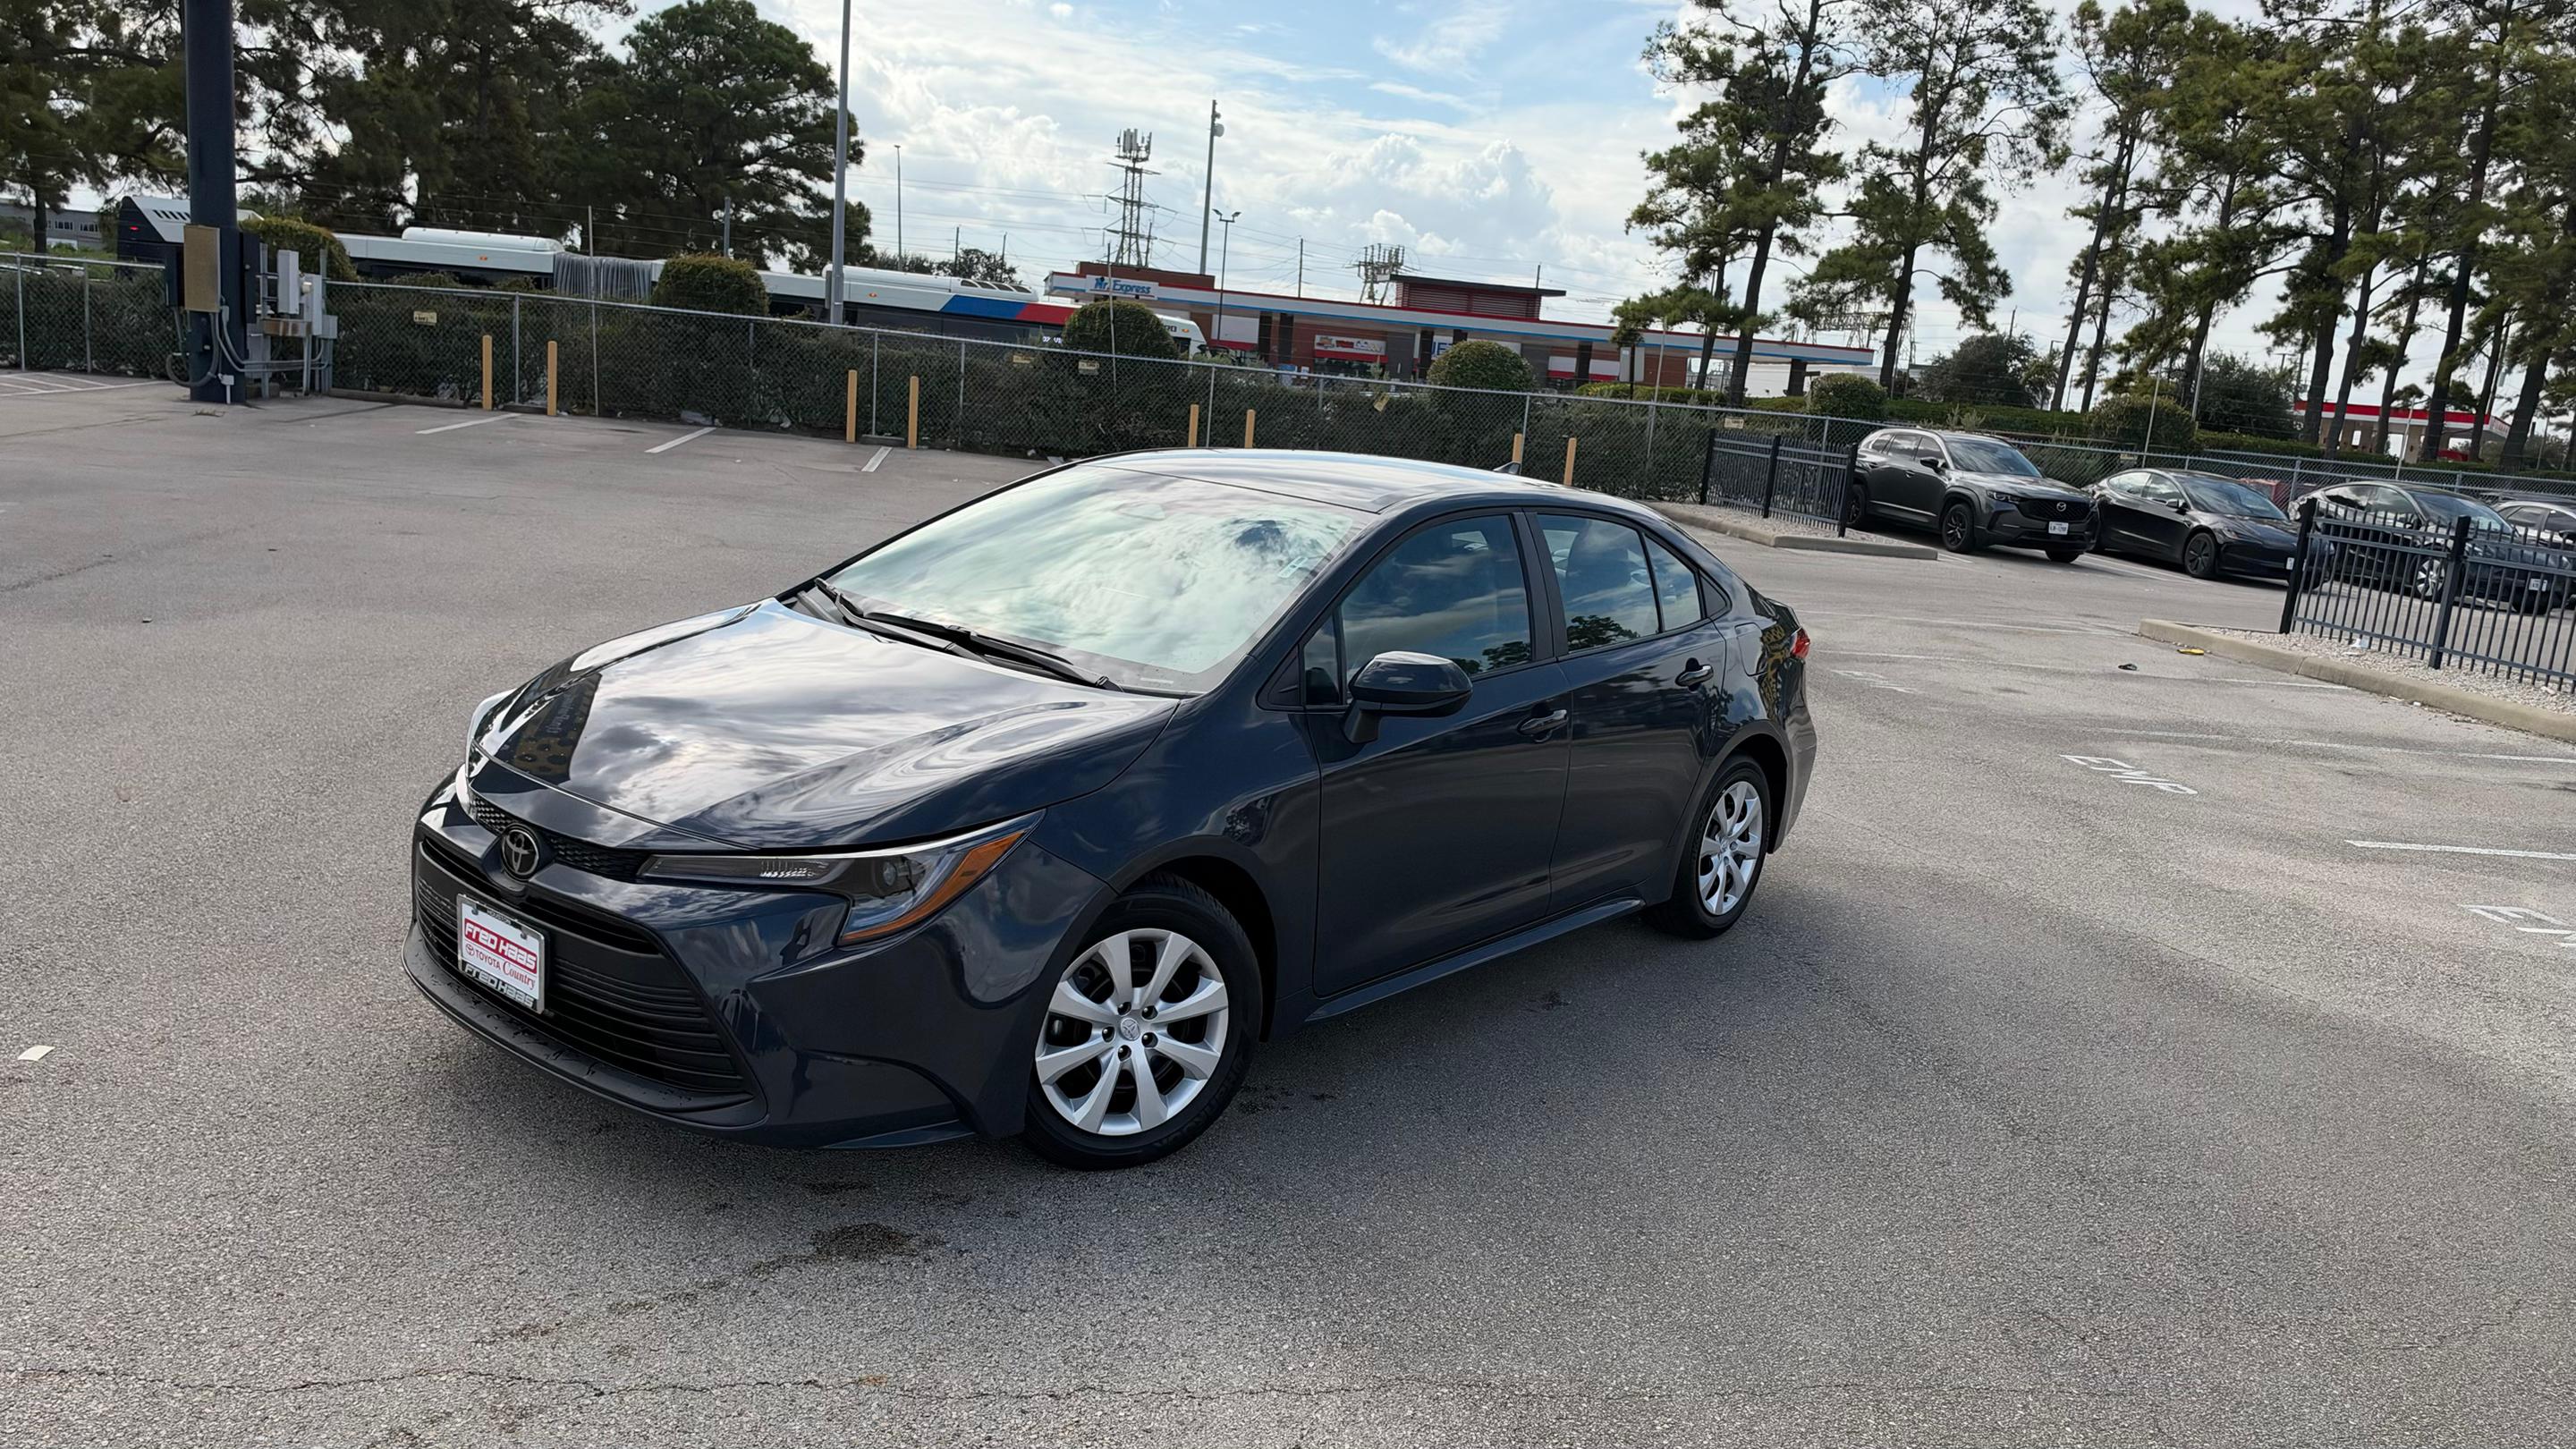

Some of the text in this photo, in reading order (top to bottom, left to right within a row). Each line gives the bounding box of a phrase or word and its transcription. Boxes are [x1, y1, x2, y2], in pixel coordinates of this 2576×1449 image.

[1113, 280, 1151, 293] Express
[2059, 754, 2199, 794] EMP
[475, 949, 536, 990] TOYOTA Country
